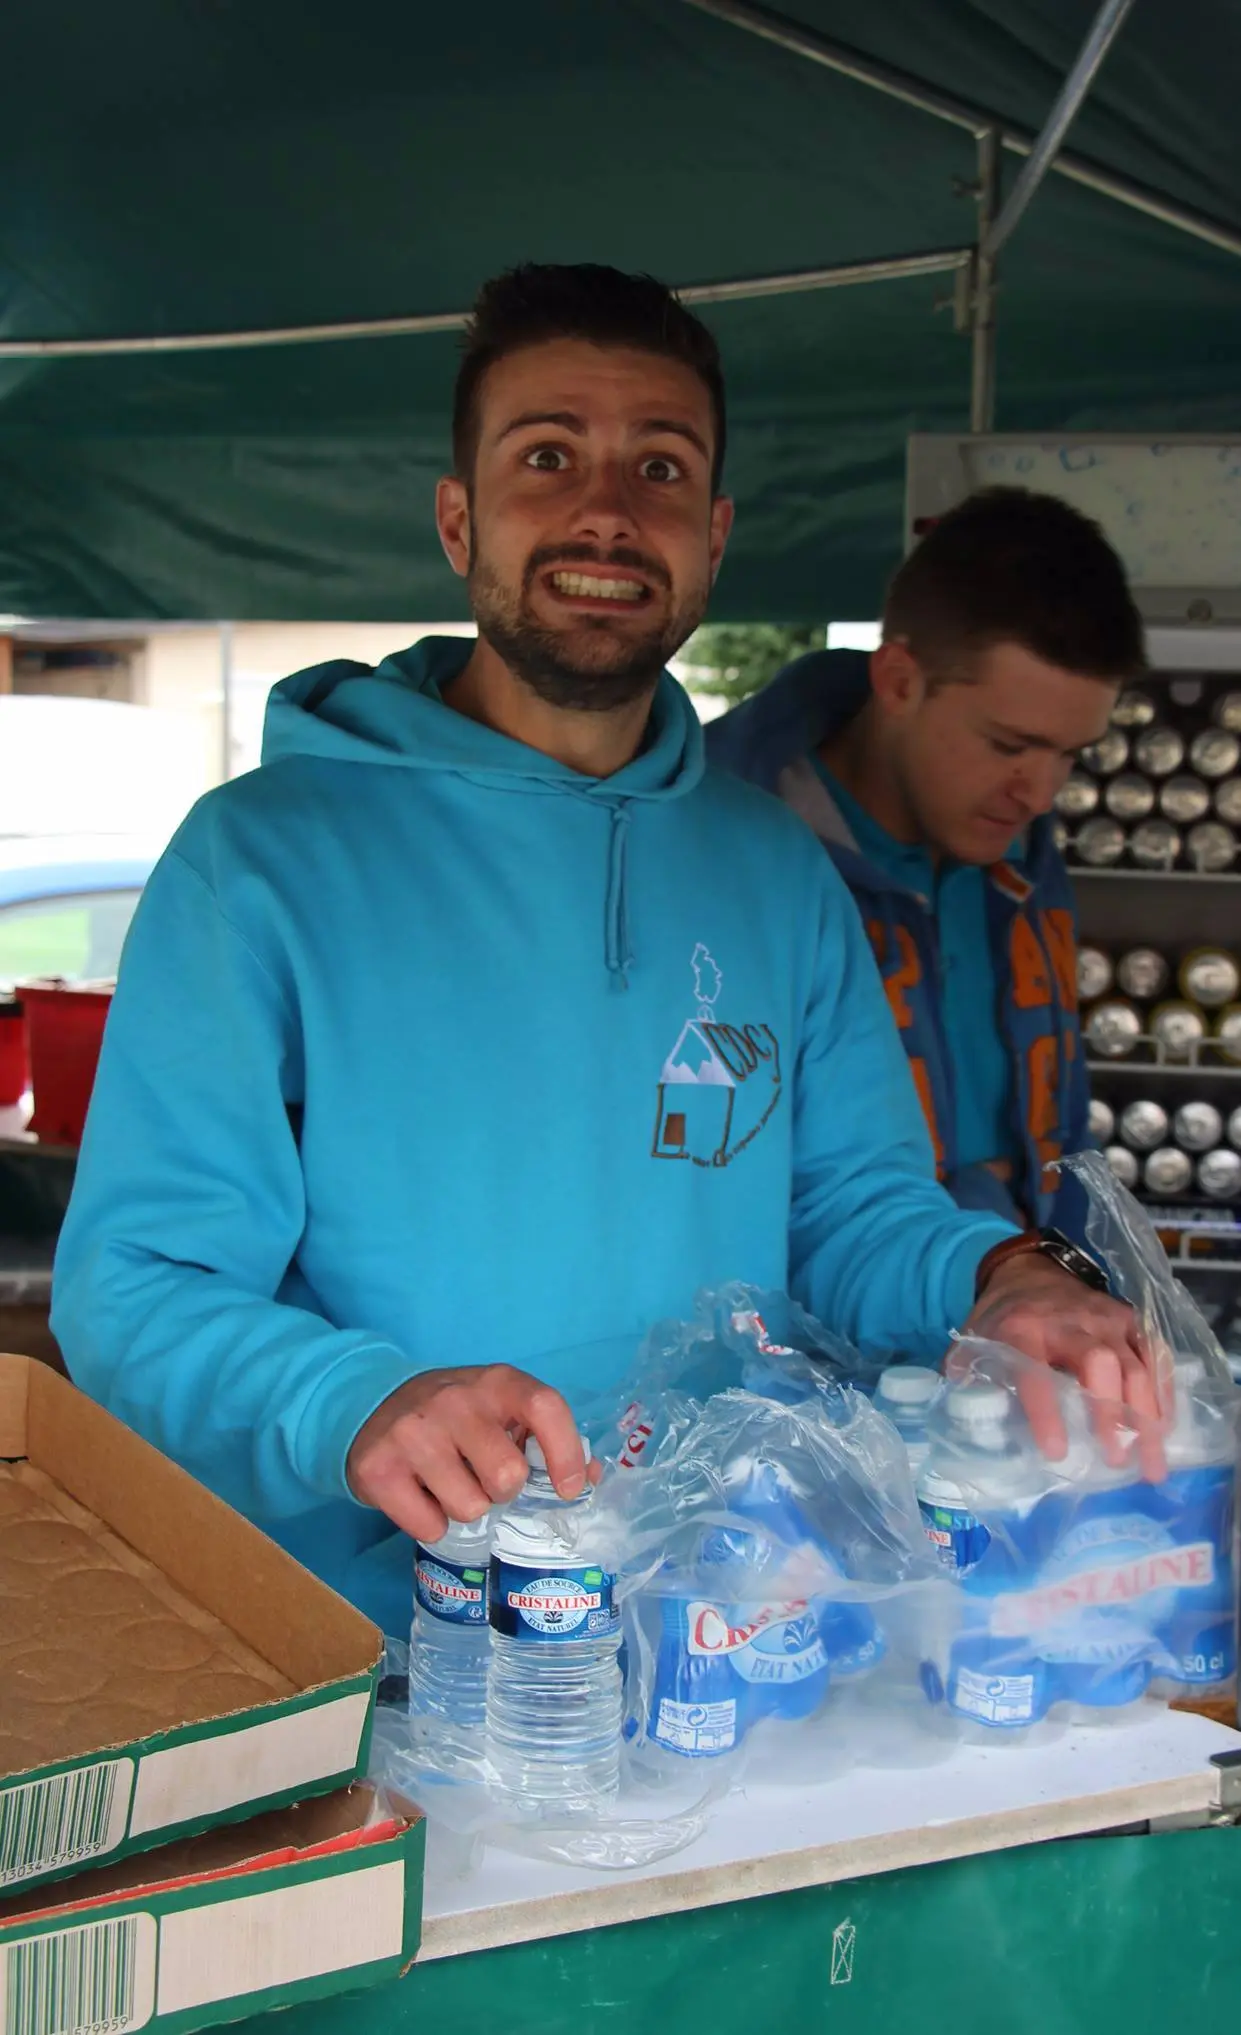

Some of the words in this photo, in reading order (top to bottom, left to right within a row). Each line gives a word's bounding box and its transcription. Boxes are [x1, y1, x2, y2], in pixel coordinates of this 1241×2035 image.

[526, 1580, 541, 1593] EAU
[541, 1579, 552, 1588] DE
[553, 1579, 582, 1593] SOURCE
[509, 1594, 598, 1609] CRISTALINE
[527, 1617, 544, 1630] ETAT
[546, 1618, 578, 1632] NATUREL
[1183, 1654, 1206, 1673] 50
[50, 1842, 101, 1868] 579959
